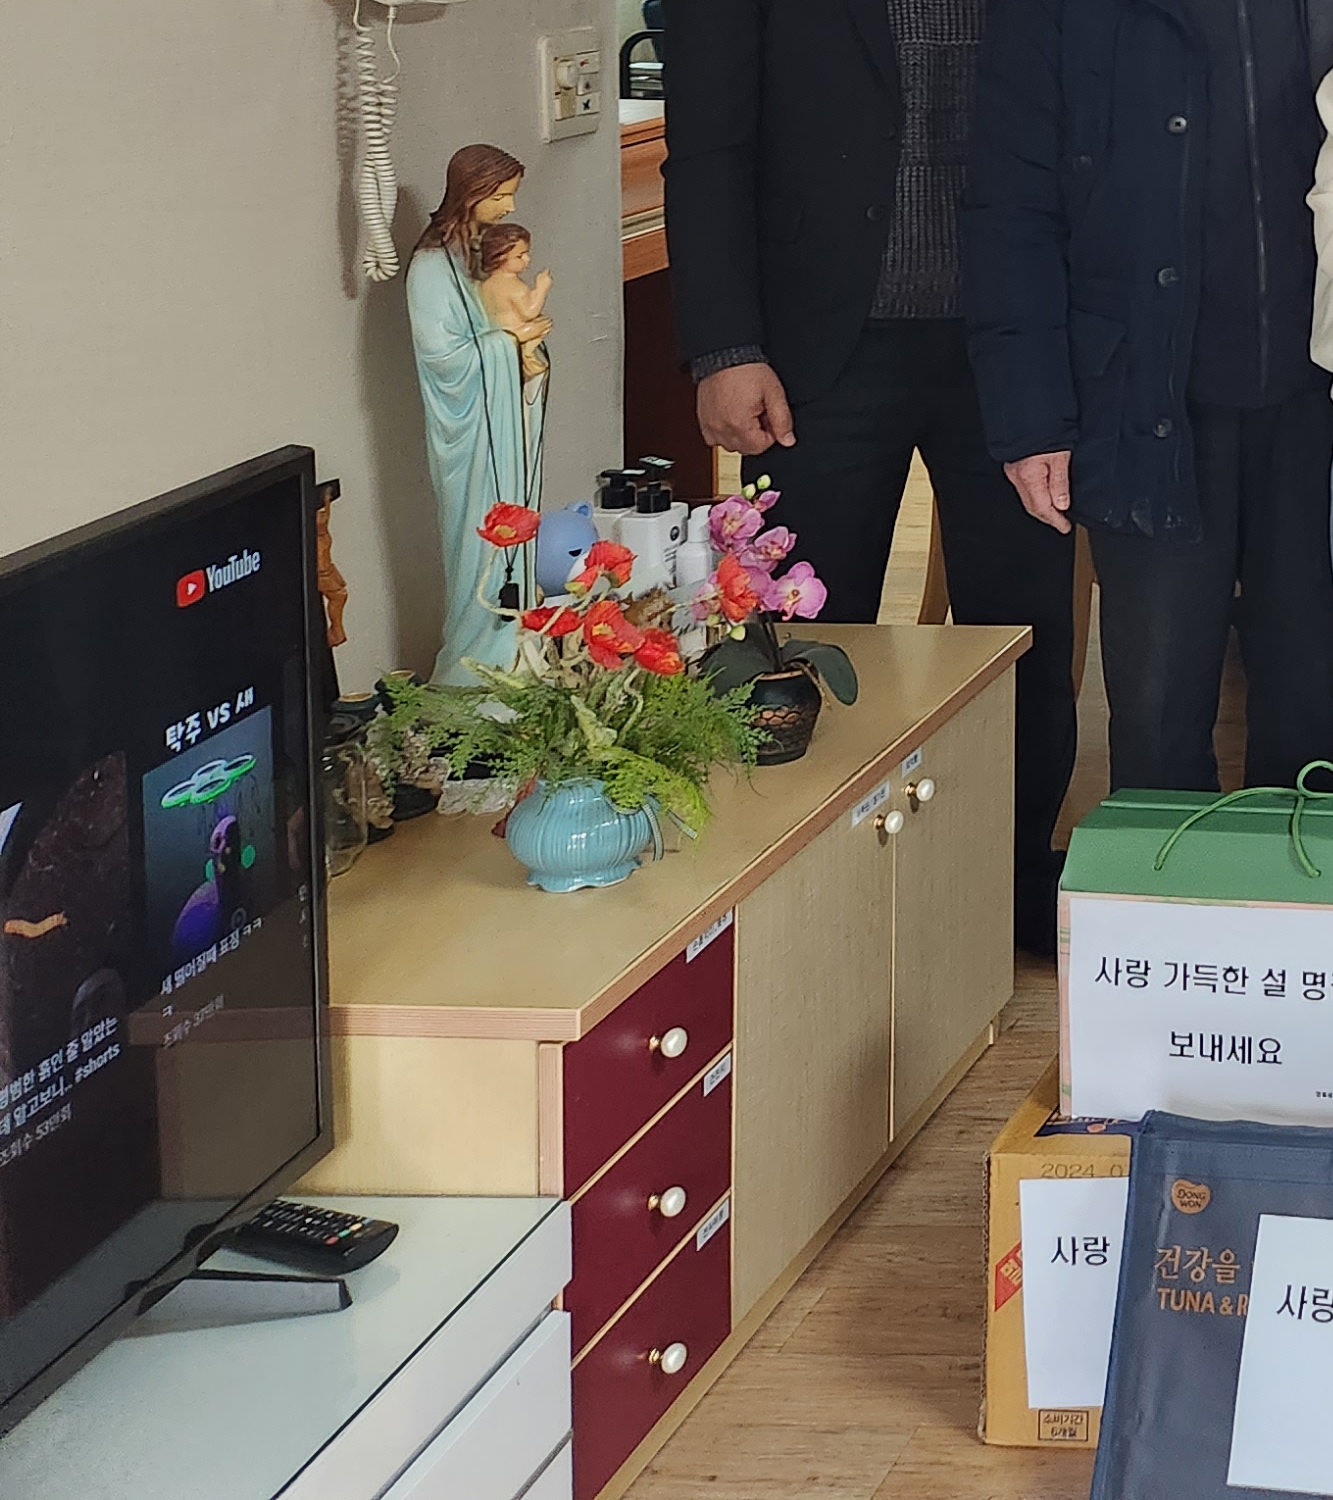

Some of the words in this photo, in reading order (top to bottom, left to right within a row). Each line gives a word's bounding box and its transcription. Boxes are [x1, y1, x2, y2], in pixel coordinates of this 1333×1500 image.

[206, 548, 261, 593] YouTube
[206, 702, 231, 730] VS
[1094, 956, 1152, 989] 사랑
[1163, 961, 1250, 996] 가득한
[1261, 968, 1287, 998] 설
[1168, 1030, 1283, 1065] 보내세요
[1041, 1162, 1095, 1179] 2024
[1177, 1188, 1207, 1200] DONG
[1050, 1235, 1111, 1267] 사랑
[1154, 1245, 1241, 1285] 건강을
[1157, 1287, 1216, 1314] TUNA
[1219, 1296, 1234, 1314] &
